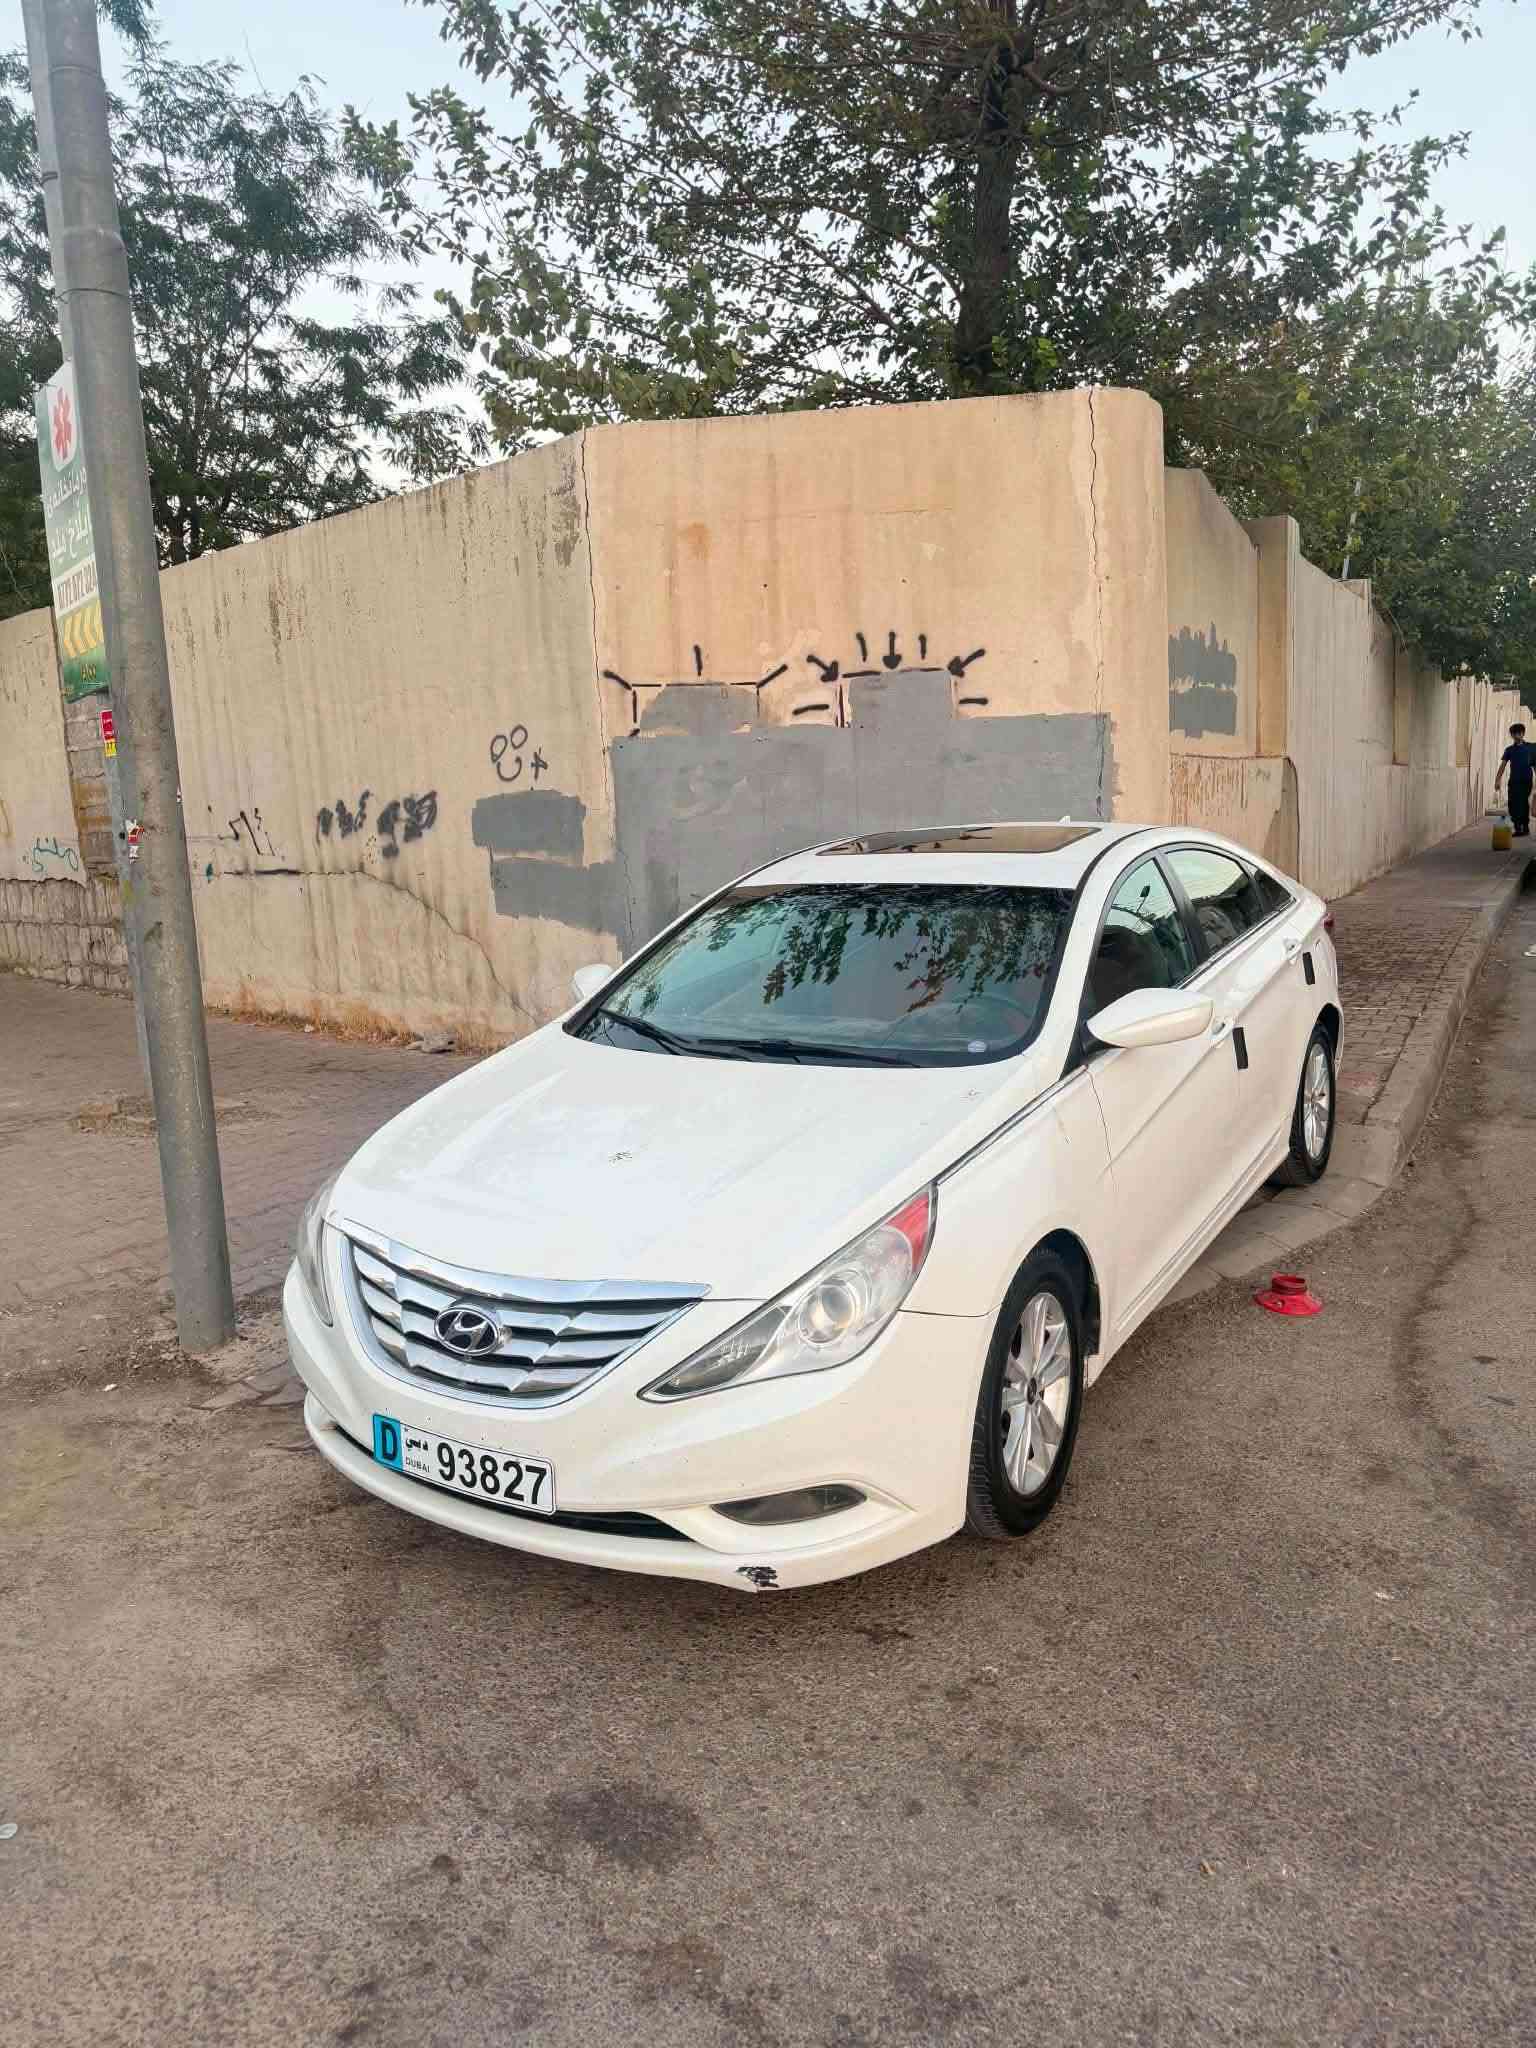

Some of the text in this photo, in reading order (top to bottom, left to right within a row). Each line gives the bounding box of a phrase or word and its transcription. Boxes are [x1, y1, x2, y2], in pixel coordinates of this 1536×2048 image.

[381, 1421, 398, 1462] D
[405, 1457, 430, 1474] DUBAI
[437, 1441, 547, 1505] 93827
